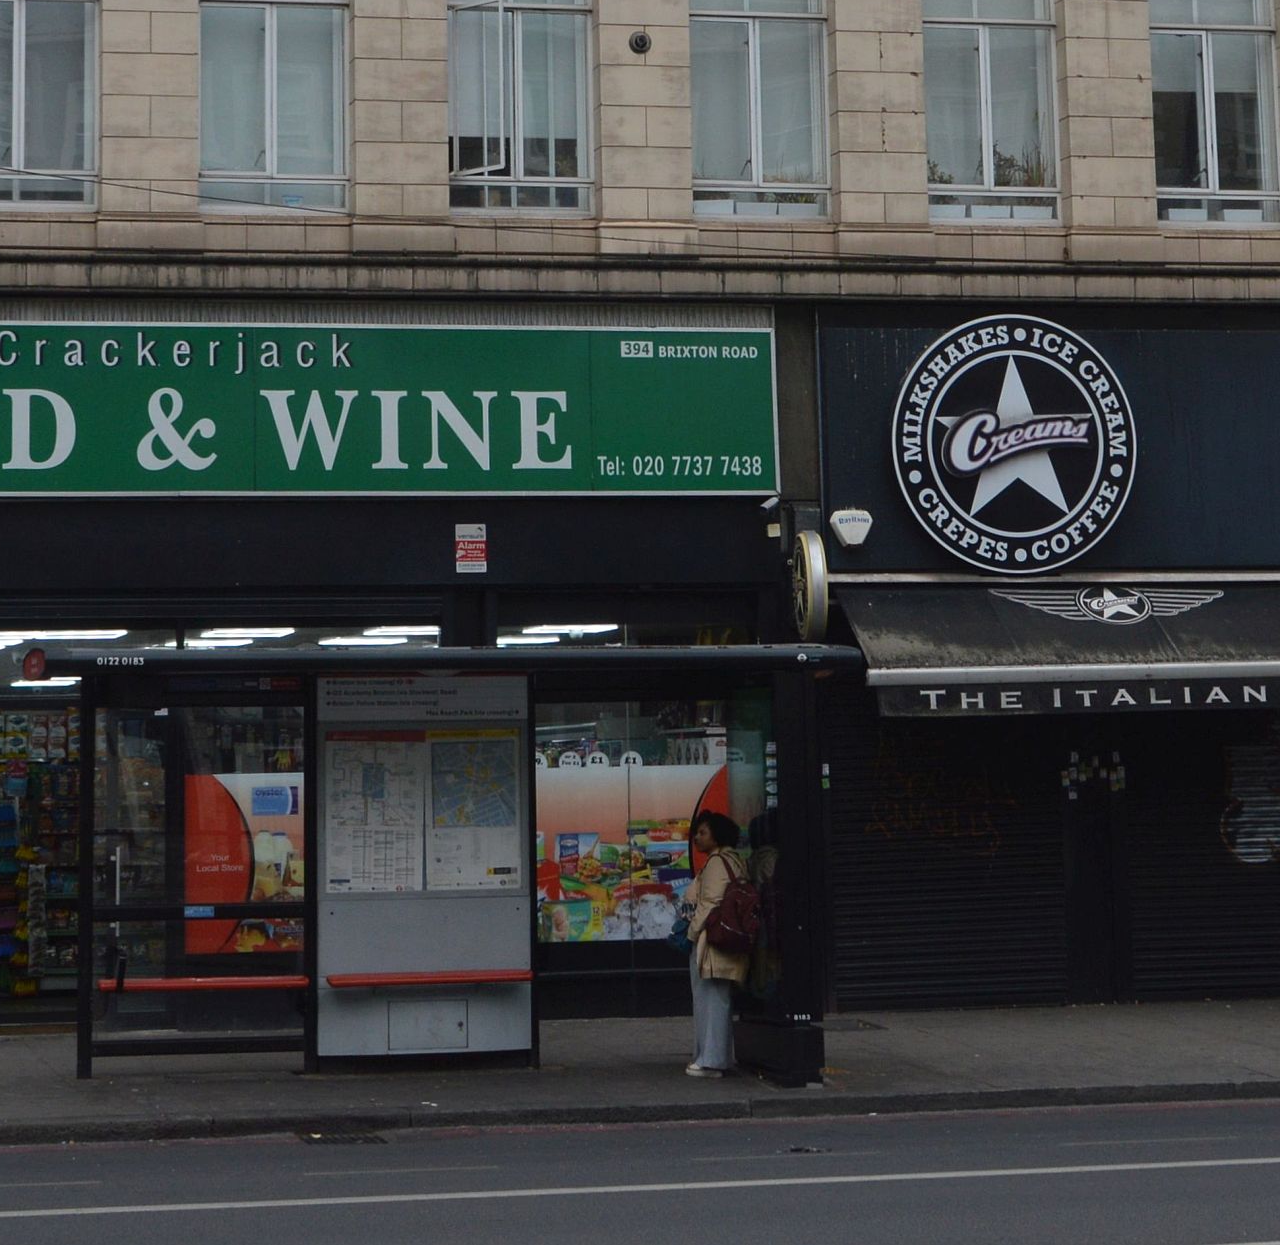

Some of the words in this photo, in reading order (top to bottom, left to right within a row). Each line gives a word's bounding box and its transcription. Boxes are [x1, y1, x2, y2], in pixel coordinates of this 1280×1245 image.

[623, 342, 651, 356] 394
[658, 345, 718, 358] BRIXTON
[722, 346, 758, 358] ROAD
[903, 325, 1010, 463] MILKSHAKES
[1030, 327, 1079, 365] ICE
[1078, 359, 1128, 458] CREAM
[136, 387, 218, 472] &
[260, 389, 573, 472] WINE
[947, 411, 1091, 473] Creams
[597, 456, 625, 476] Tel:
[632, 456, 664, 476] 020
[671, 456, 713, 476] 7737
[720, 456, 762, 476] 7438
[919, 487, 1009, 562] CREPES
[1031, 480, 1120, 561] COFFEE
[458, 541, 485, 550] Alarm
[96, 657, 120, 666] 0122
[121, 657, 145, 666] 0183
[920, 688, 1023, 710] THE
[1053, 685, 1267, 709] ITALIAN
[590, 756, 604, 765] £1
[255, 787, 285, 797] oyster
[210, 853, 231, 862] Your
[196, 864, 219, 873] Local
[221, 863, 244, 872] Store
